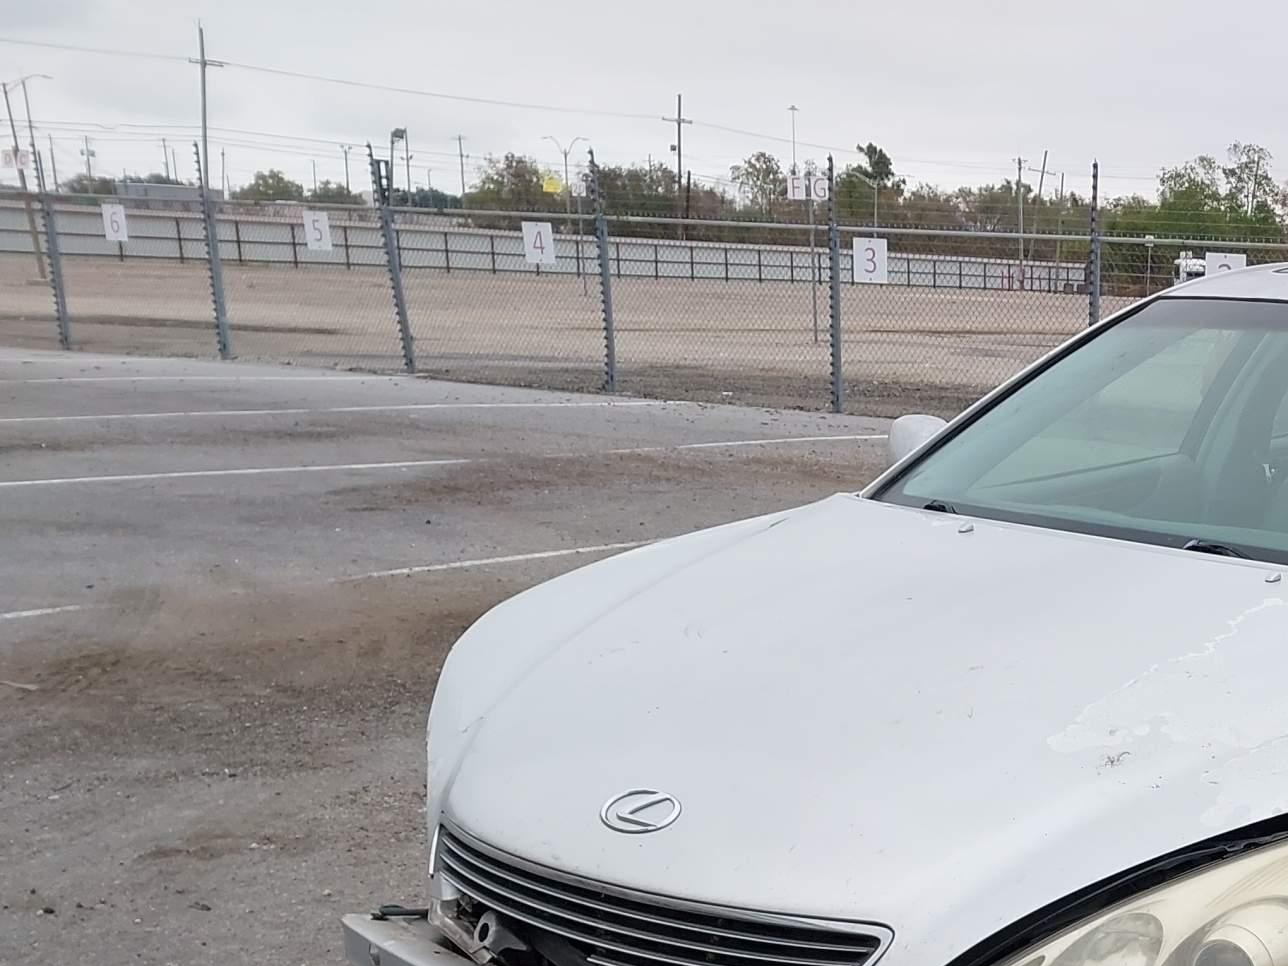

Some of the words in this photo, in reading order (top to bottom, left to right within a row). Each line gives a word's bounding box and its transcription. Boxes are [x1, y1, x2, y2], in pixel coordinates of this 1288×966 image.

[791, 177, 801, 198] F
[813, 177, 827, 199] G
[109, 211, 120, 234] 6
[311, 218, 323, 242] 5
[533, 230, 545, 254] 4
[864, 247, 877, 273] 3
